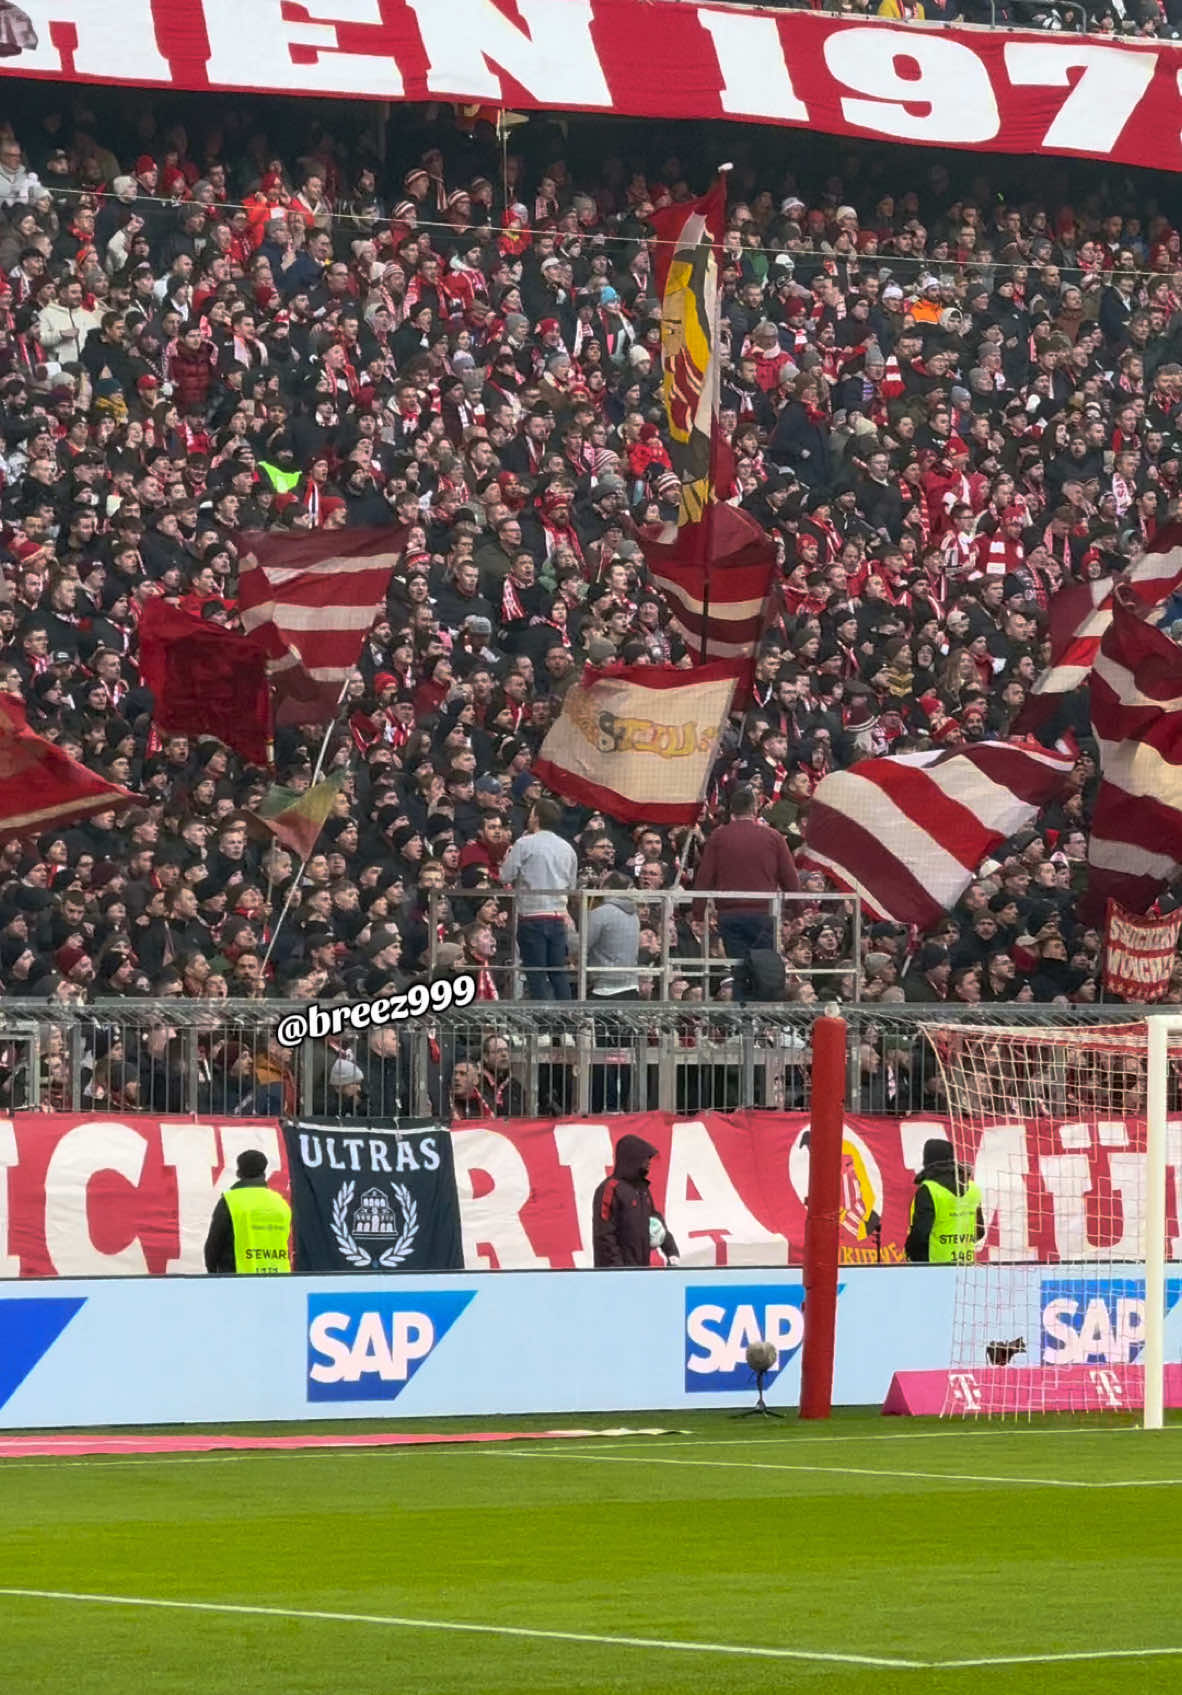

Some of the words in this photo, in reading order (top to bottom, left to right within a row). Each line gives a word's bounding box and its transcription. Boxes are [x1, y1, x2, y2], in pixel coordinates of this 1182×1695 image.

[697, 9, 1182, 153] 197
[299, 1134, 440, 1172] ULTRAS
[900, 1120, 1182, 1262] MÜ
[245, 1248, 288, 1260] STEWAR
[310, 1311, 434, 1383] SAP
[687, 1304, 805, 1374] SAP
[1042, 1298, 1146, 1364] SAP
